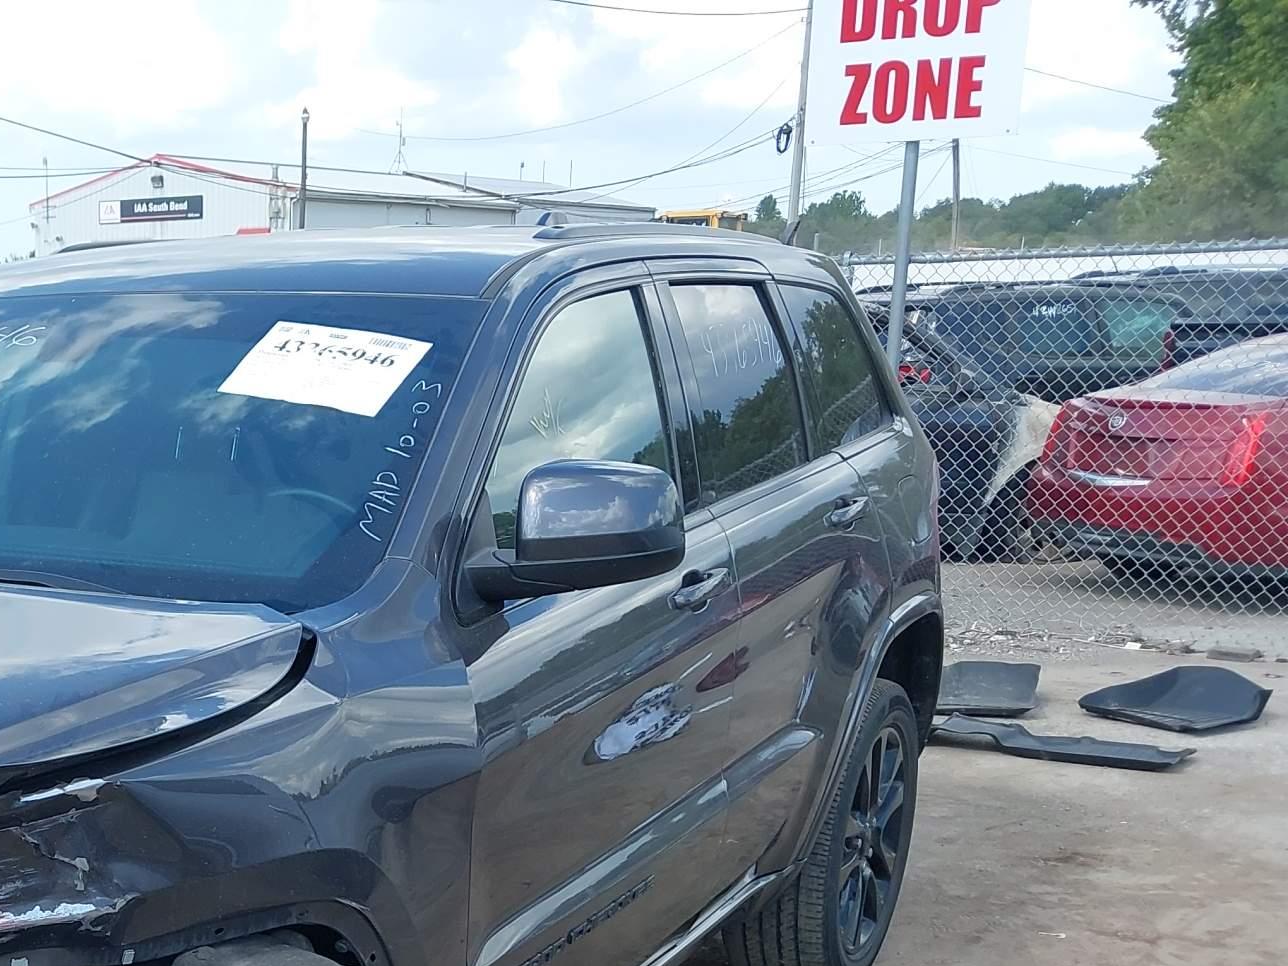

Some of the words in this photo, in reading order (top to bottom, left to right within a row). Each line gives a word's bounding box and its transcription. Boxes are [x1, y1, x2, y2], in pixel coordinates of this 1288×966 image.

[840, 0, 1000, 43] DROP
[840, 55, 986, 125] ZONE
[134, 202, 147, 213] IAA
[148, 201, 168, 213] South
[169, 200, 188, 211] Bend
[359, 471, 401, 542] MAD
[384, 379, 442, 458] 10-03
